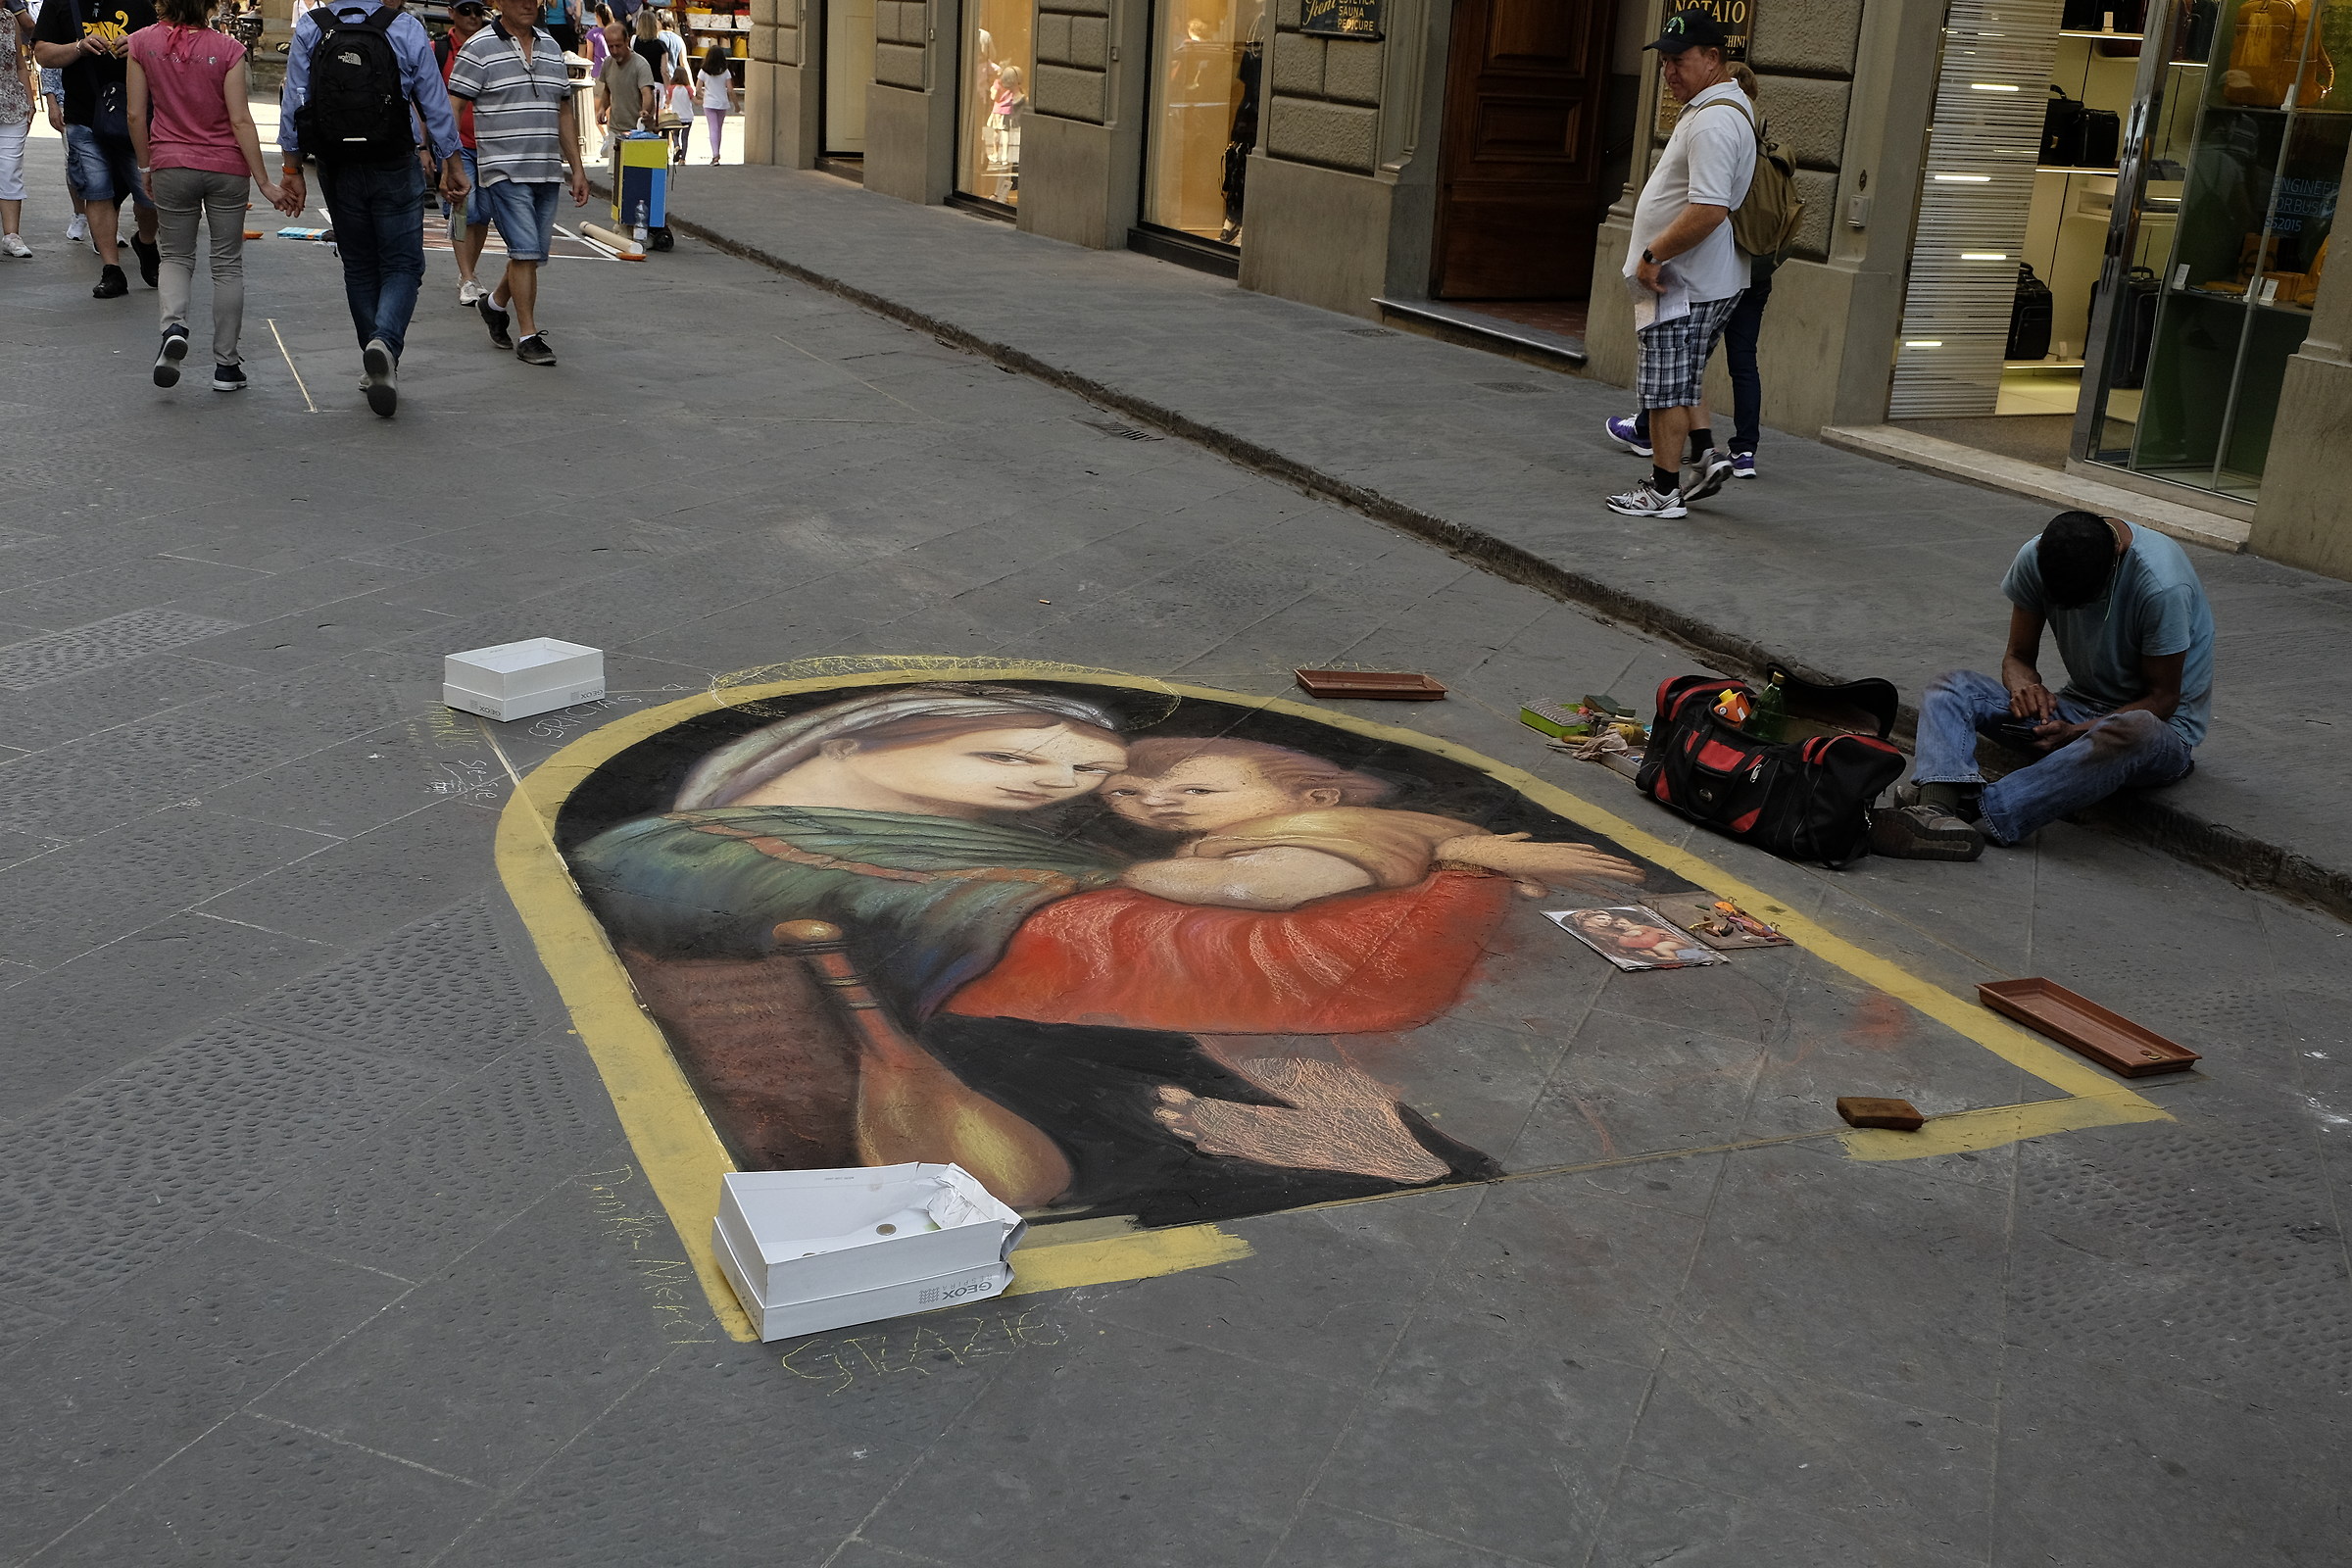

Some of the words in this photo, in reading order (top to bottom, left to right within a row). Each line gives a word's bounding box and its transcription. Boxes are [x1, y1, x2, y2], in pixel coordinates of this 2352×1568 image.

[1339, 6, 1364, 18] SAUNA
[1338, 19, 1374, 31] PEDICURE
[581, 689, 604, 700] GEOX
[479, 705, 501, 717] GEOX
[942, 1281, 993, 1300] GEOX
